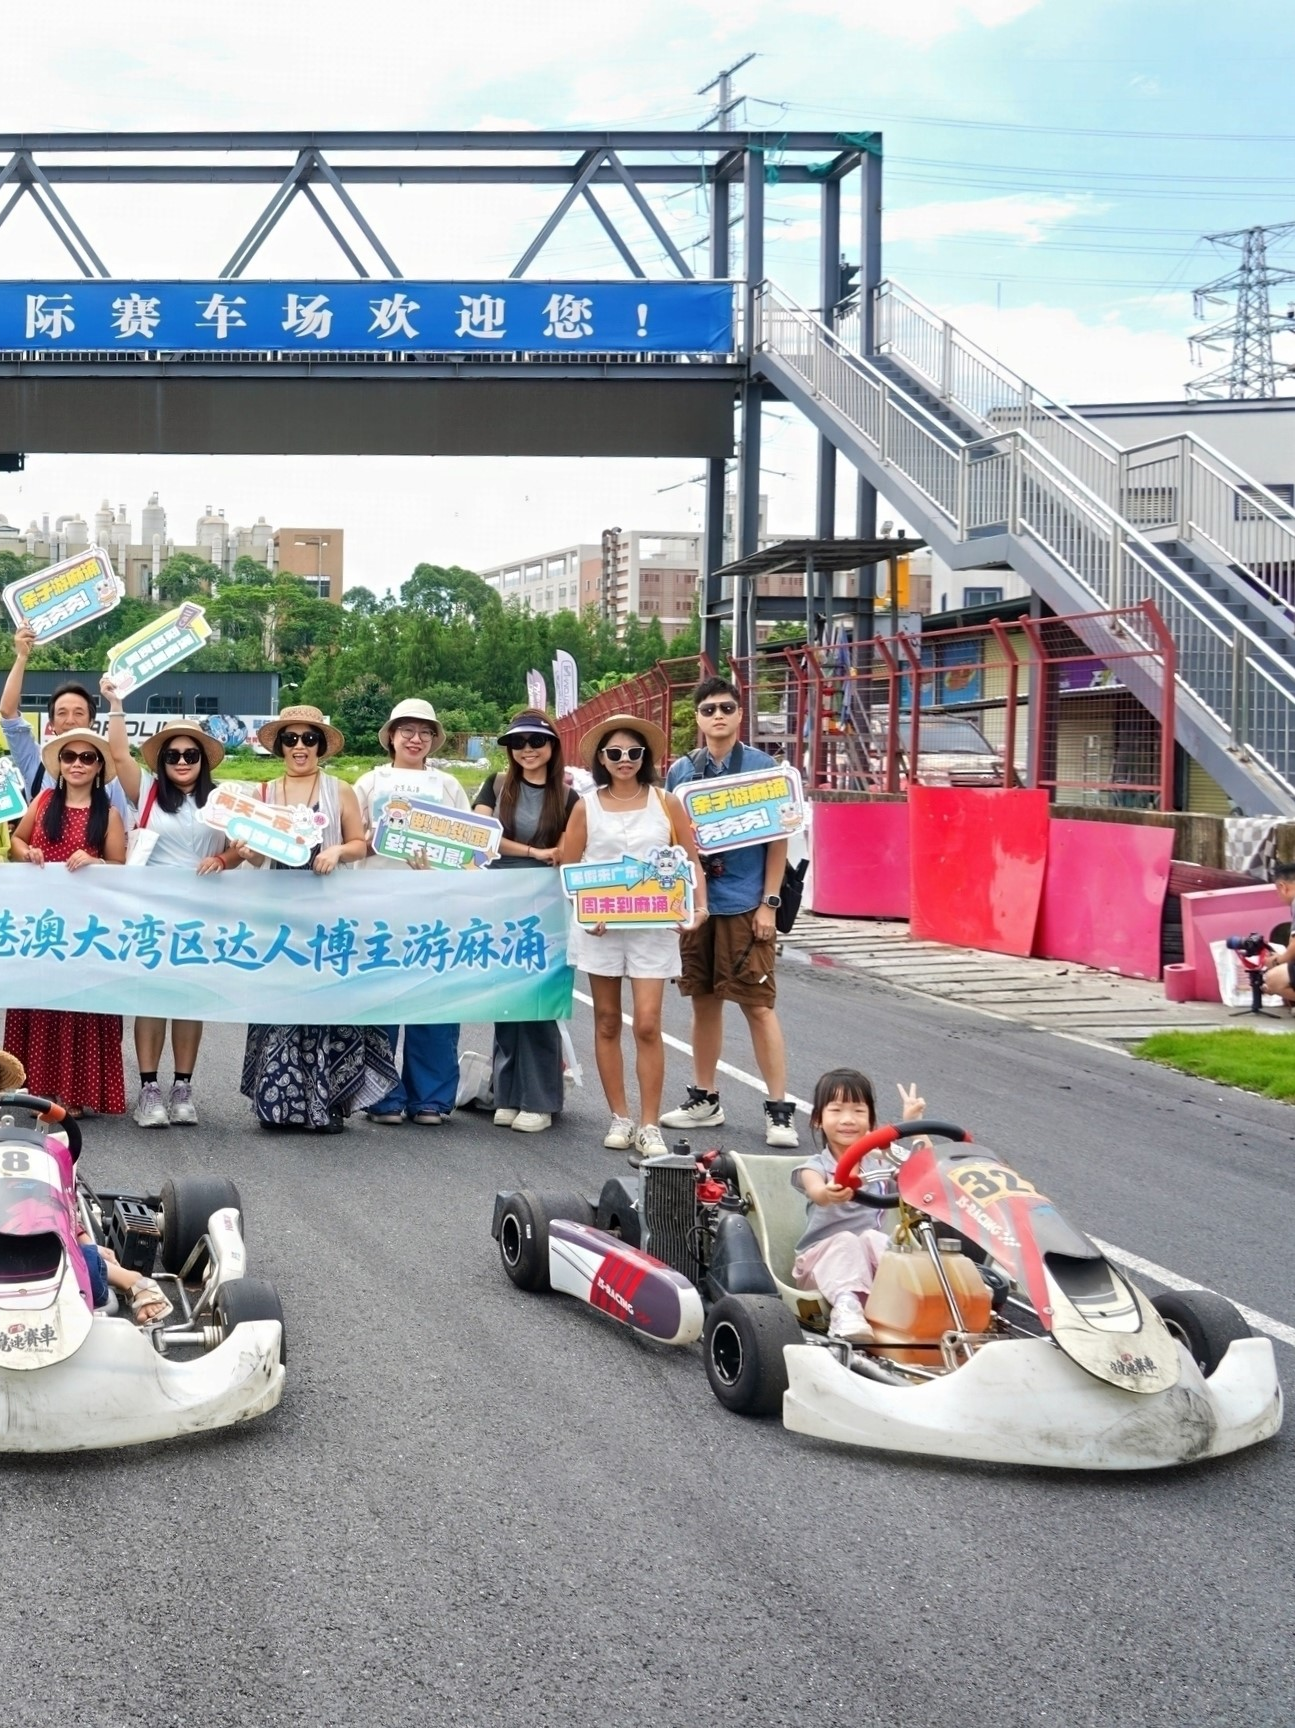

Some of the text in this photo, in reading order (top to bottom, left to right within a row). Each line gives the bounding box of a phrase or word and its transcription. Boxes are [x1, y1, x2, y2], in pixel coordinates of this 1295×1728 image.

[19, 557, 102, 611] 亲子游麻涌
[691, 779, 789, 817] 亲子游麻涌
[570, 866, 641, 886] 暑假来广东
[581, 896, 669, 914] 周末到麻涌
[1, 1151, 30, 1172] 8
[958, 1170, 1032, 1199] 32
